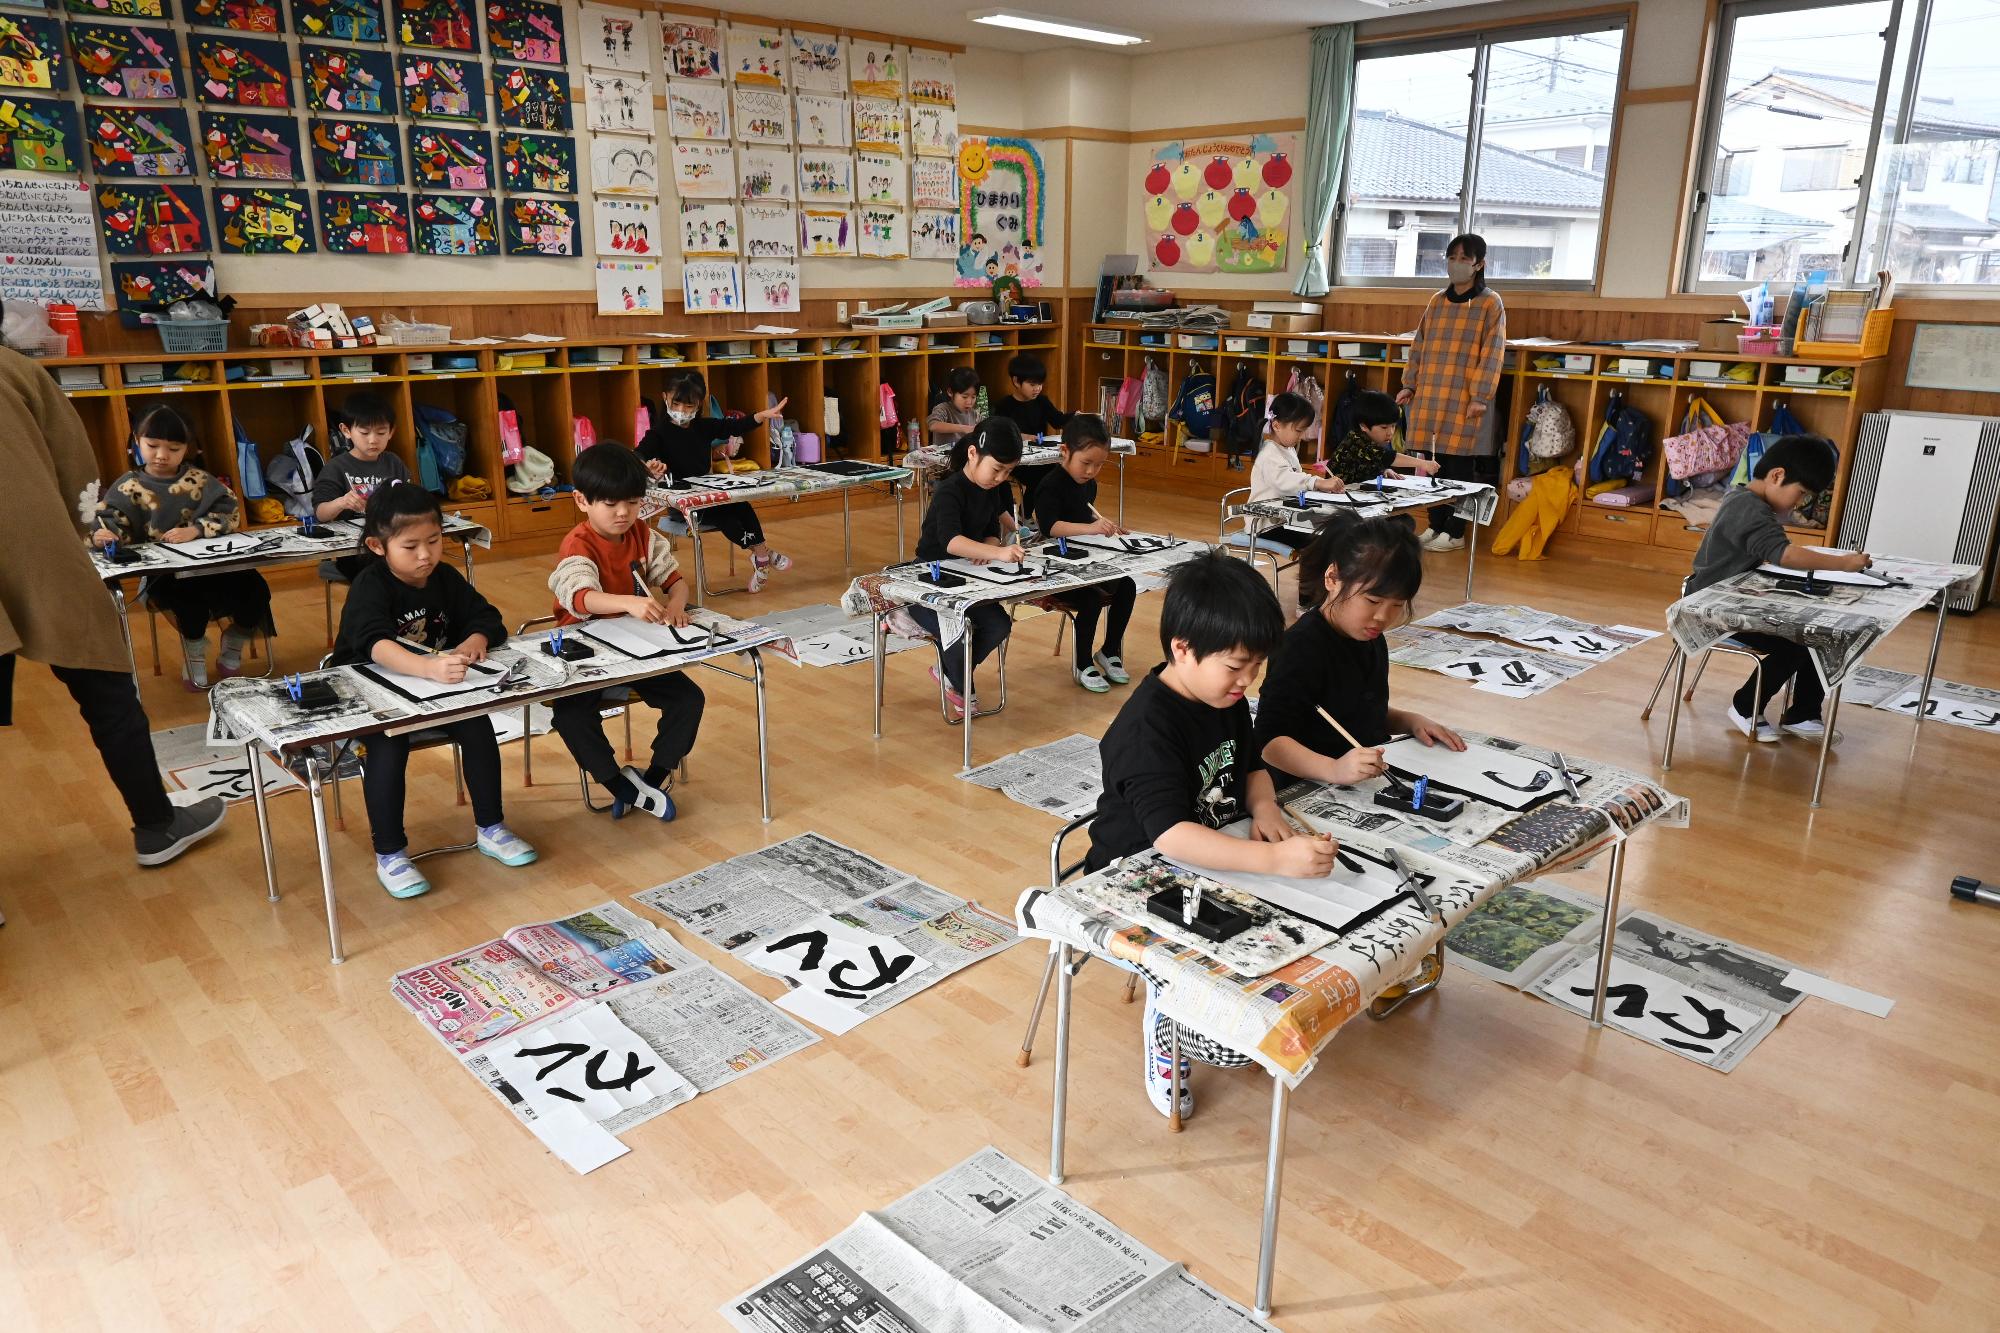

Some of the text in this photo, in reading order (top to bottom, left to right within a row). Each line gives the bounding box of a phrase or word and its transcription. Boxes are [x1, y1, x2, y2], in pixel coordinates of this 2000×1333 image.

[1184, 166, 1189, 174] 5
[1246, 160, 1251, 169] 7
[976, 193, 1020, 208] ひまわり
[1156, 198, 1162, 206] 9
[1206, 192, 1214, 200] 11
[1271, 192, 1275, 200] 1
[997, 216, 1019, 230] ぐみ
[1197, 233, 1203, 242] 3
[18, 256, 62, 266] くりかえし
[1522, 635, 1608, 655] かく
[1447, 660, 1536, 687] かく
[766, 930, 915, 999] かく
[1571, 984, 1742, 1054] かく
[514, 1042, 656, 1104] かく
[804, 1263, 859, 1306] 資産承継
[811, 1287, 841, 1311] セミナー
